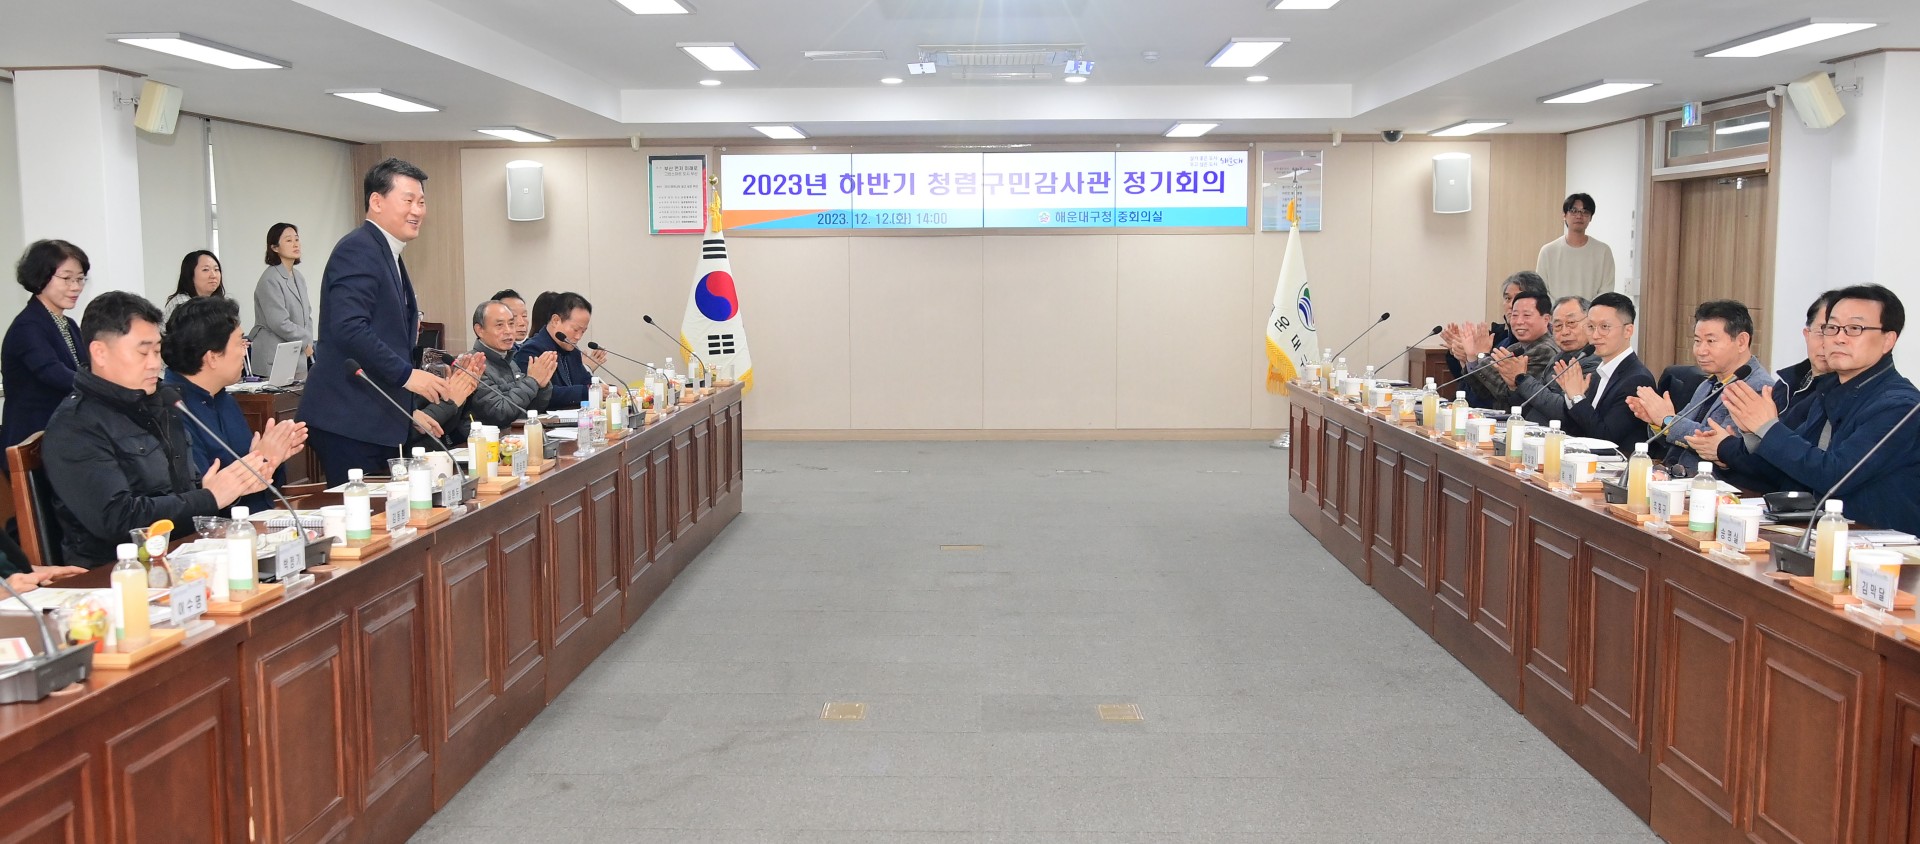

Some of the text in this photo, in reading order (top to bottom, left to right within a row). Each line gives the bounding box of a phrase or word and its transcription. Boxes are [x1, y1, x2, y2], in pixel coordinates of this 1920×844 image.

[742, 170, 1225, 196] 2023년 하반기 청렴구민감사관 정기회의
[817, 211, 948, 226] 2023. 12. 12.(화) 14:00
[1055, 209, 1163, 224] 해운대구청 중회의실
